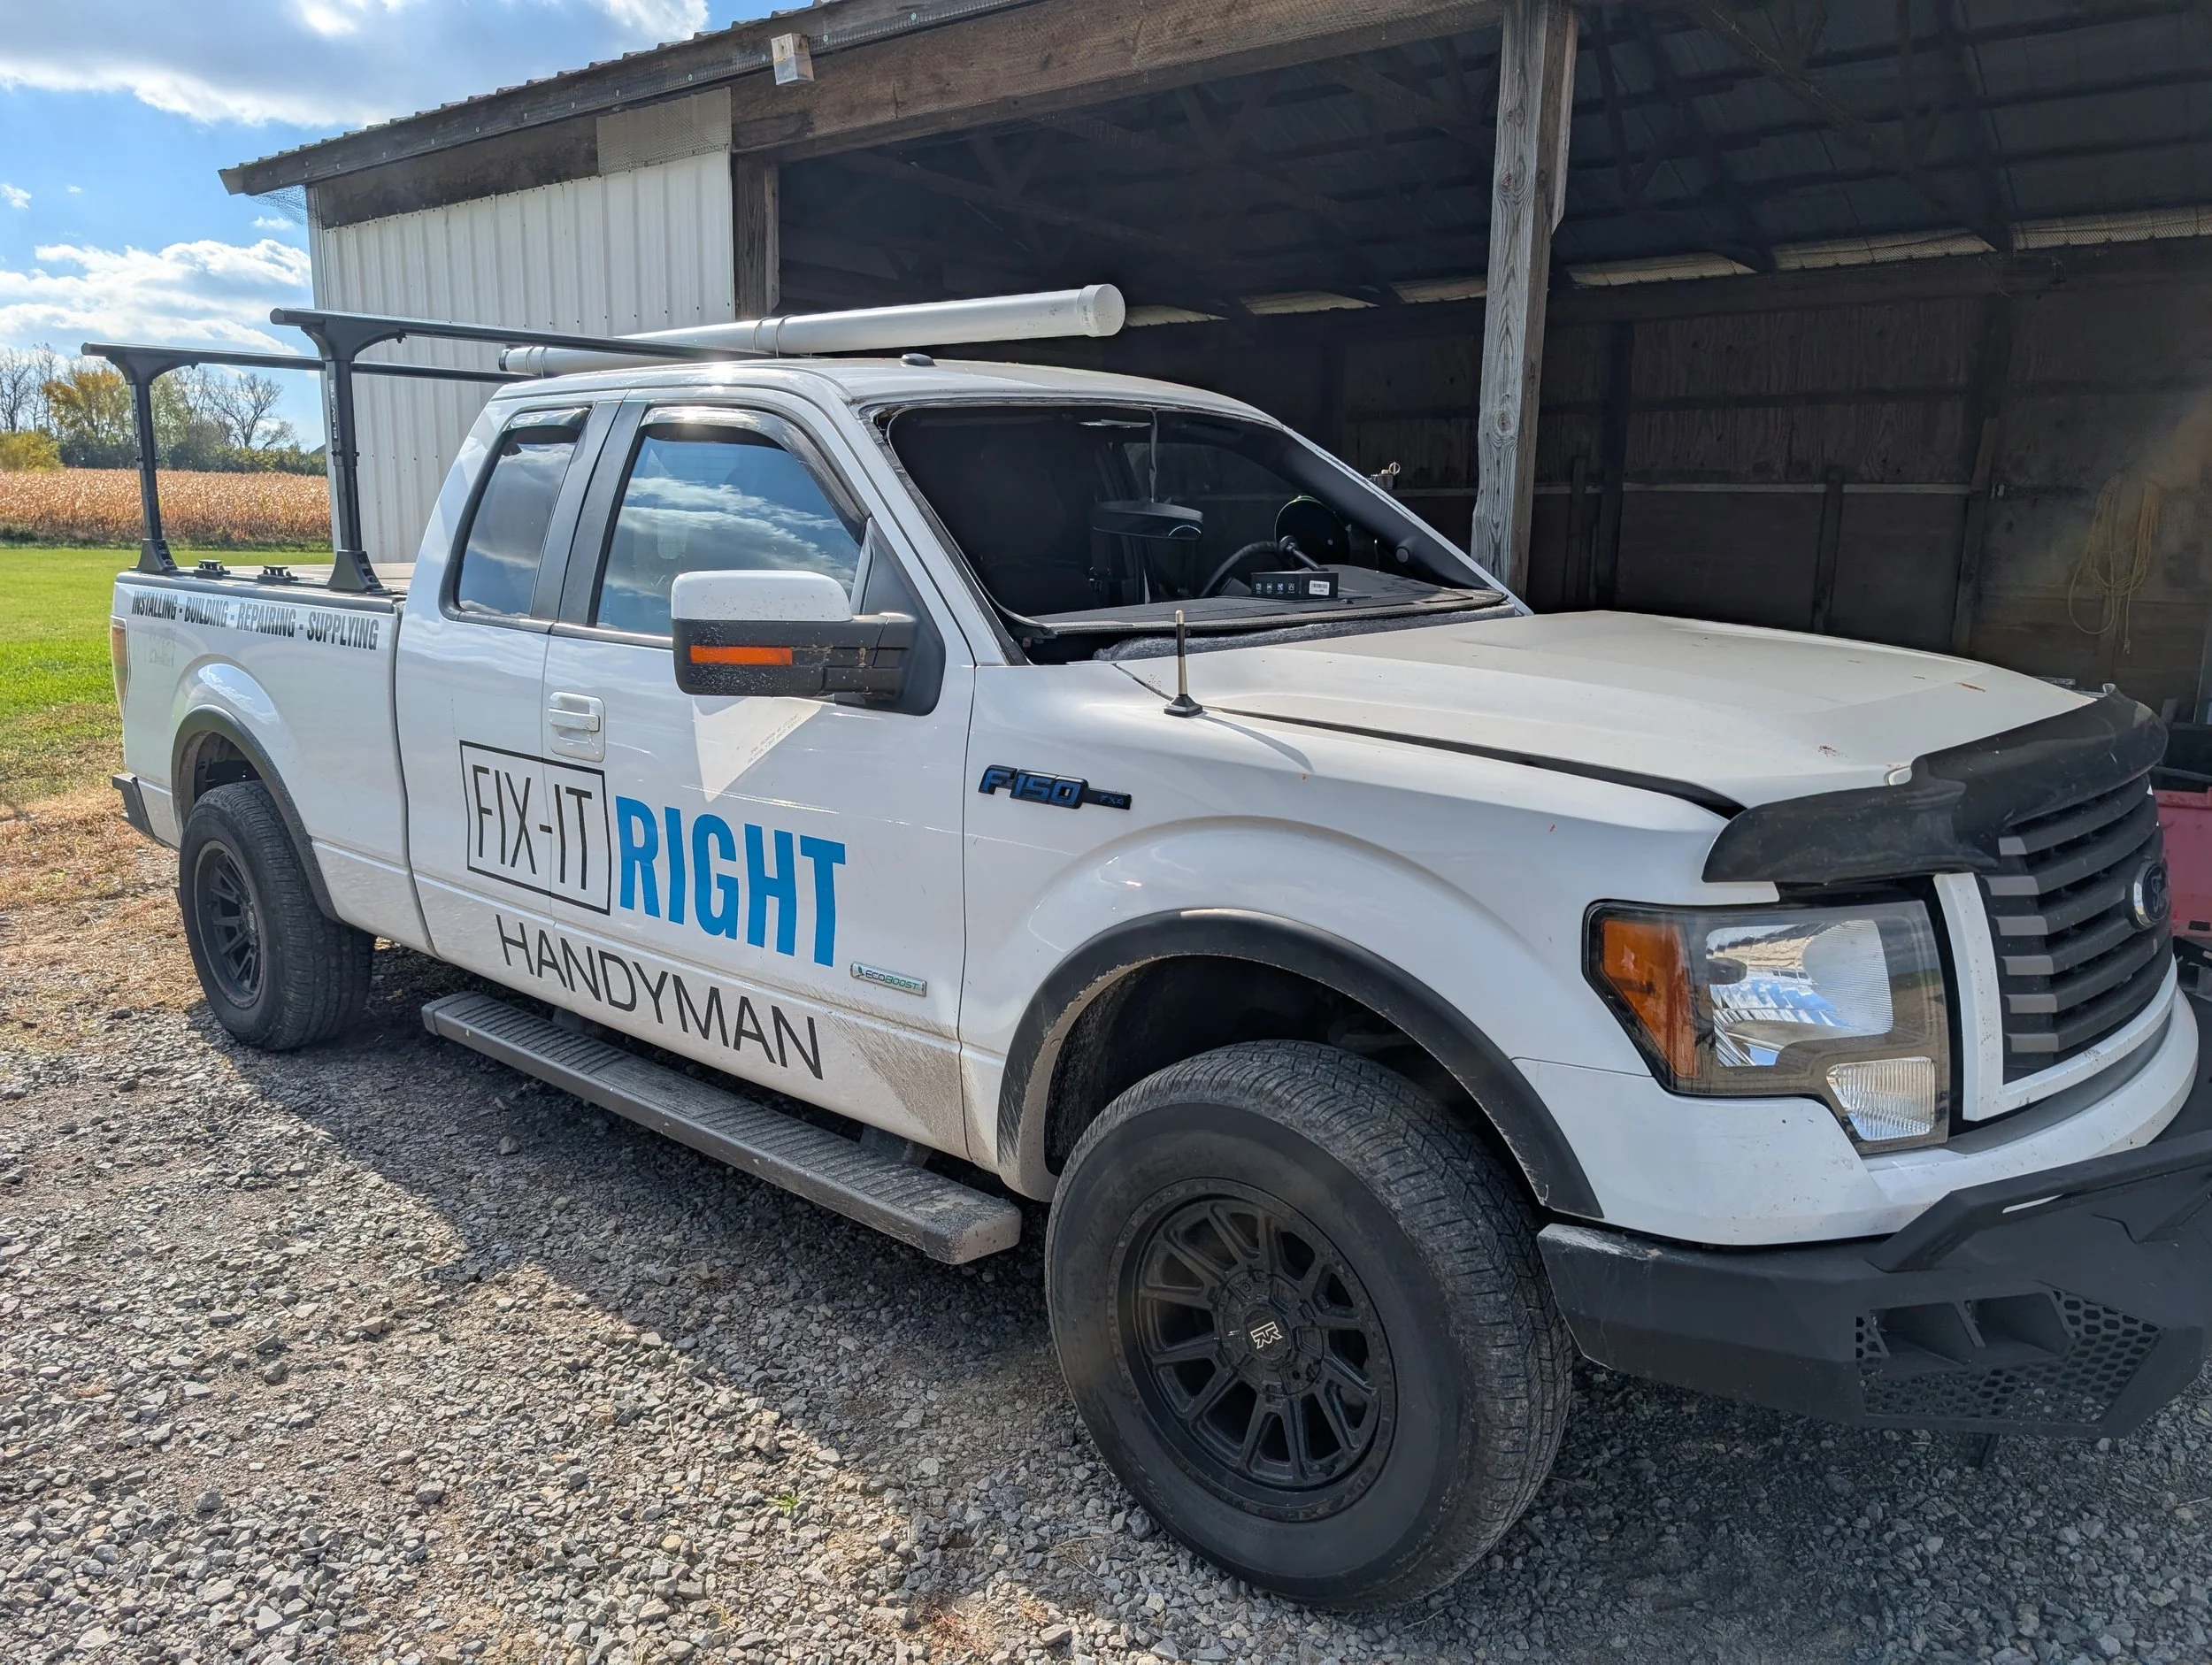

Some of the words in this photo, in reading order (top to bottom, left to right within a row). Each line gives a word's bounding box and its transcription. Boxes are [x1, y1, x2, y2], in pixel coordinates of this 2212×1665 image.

[132, 591, 177, 620] INSTALLING
[184, 596, 229, 628] BUILDING
[236, 602, 296, 638] REPAIRING
[307, 611, 380, 651] SUPPLYING
[472, 764, 593, 891] FIX-IT
[616, 795, 847, 967] RIGHT
[495, 914, 824, 1081] HANDYMAN
